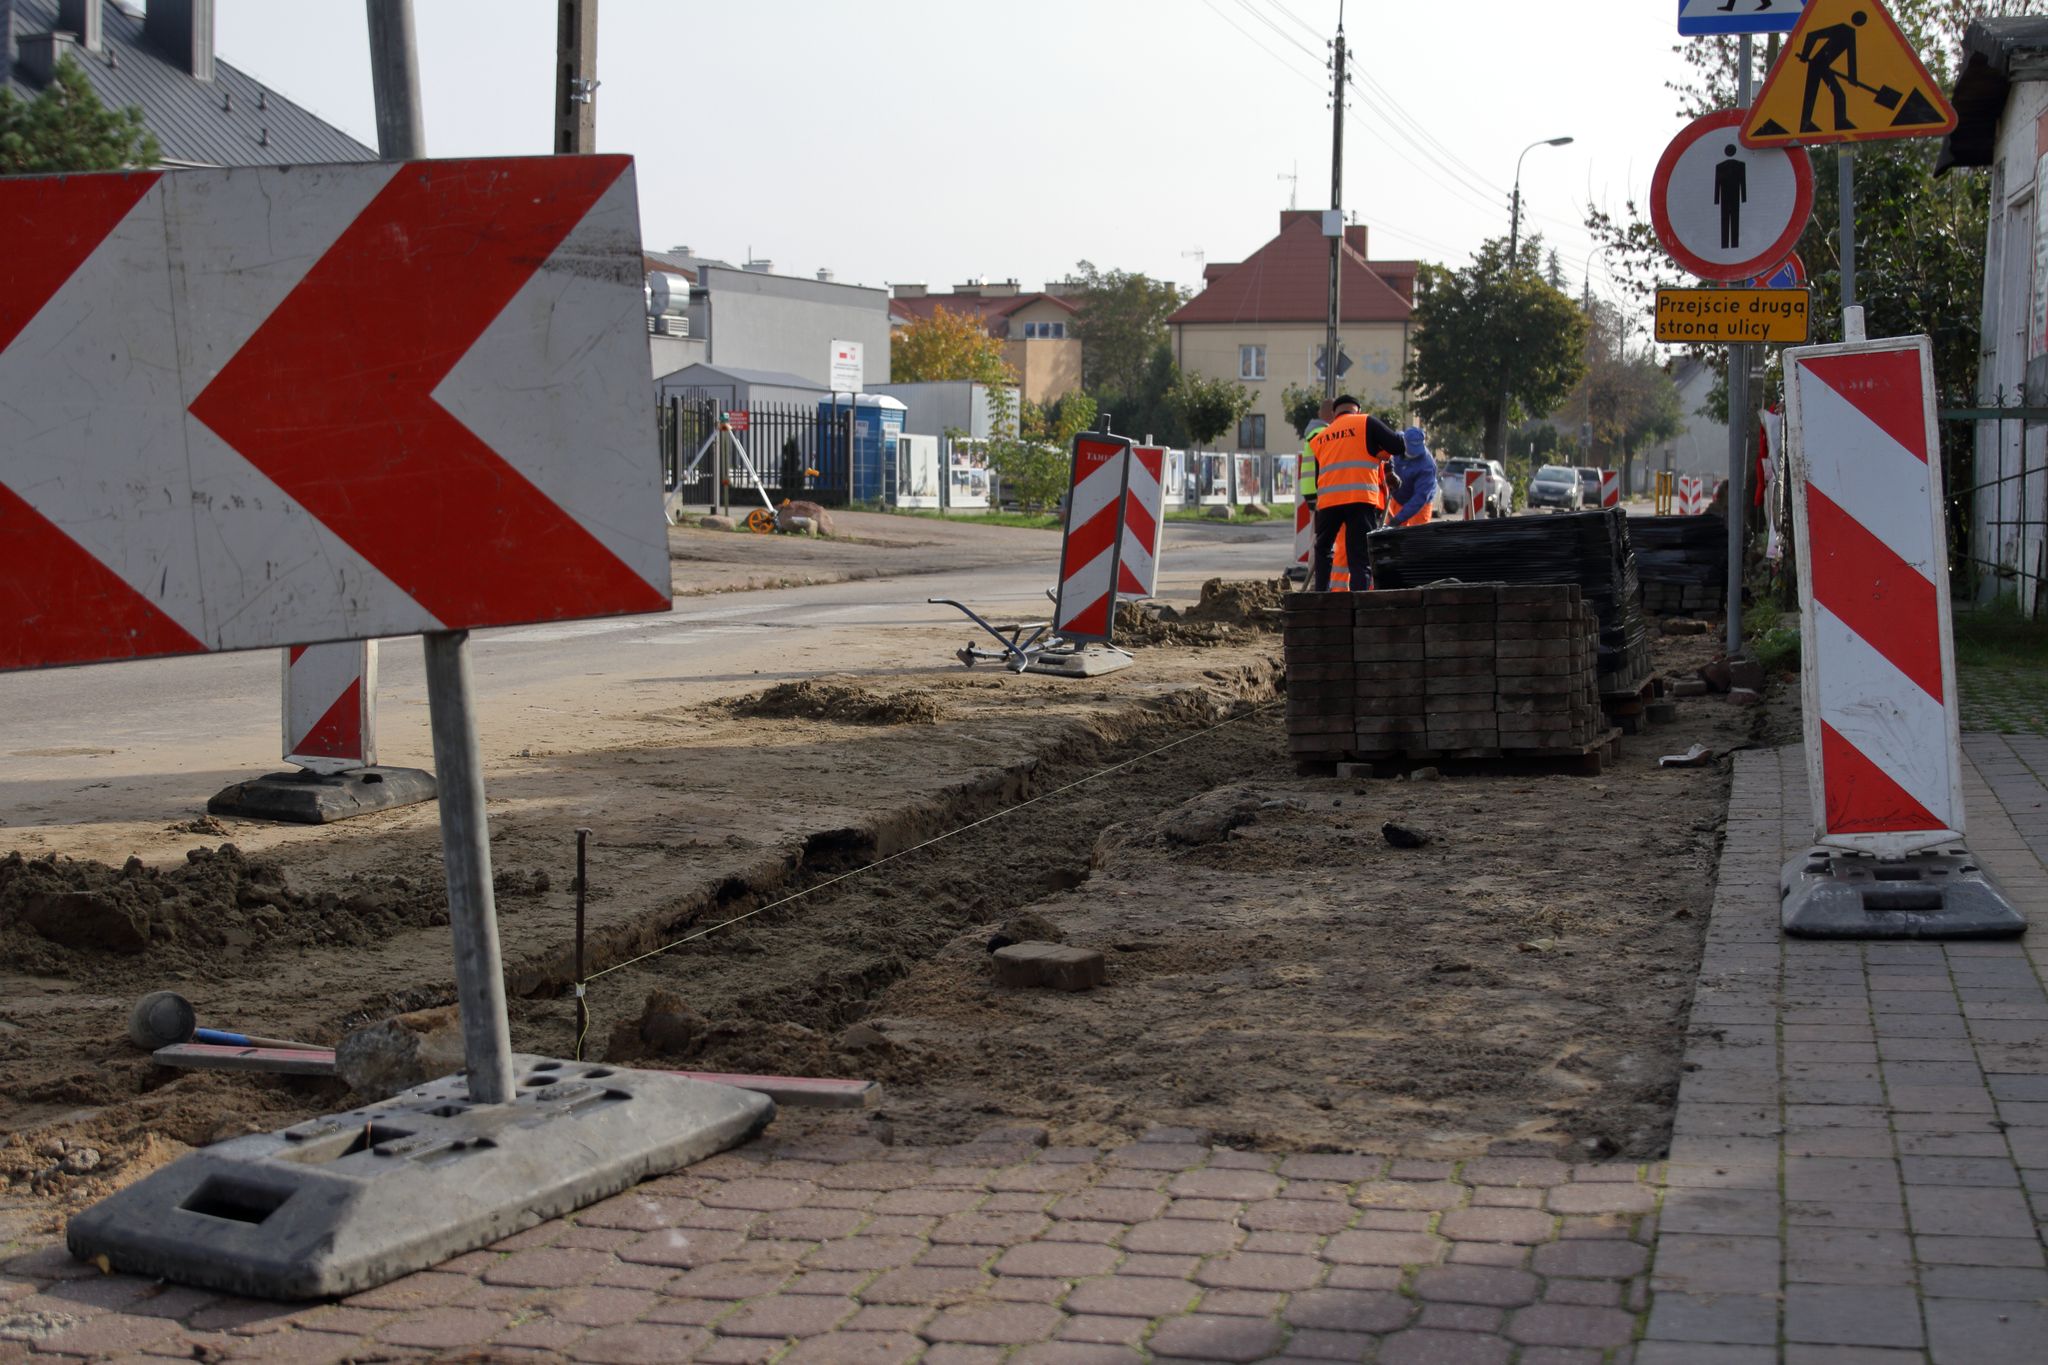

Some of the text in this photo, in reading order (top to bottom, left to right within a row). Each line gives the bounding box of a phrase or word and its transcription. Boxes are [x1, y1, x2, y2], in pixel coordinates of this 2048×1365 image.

[1660, 296, 1805, 318] Przejście drugą
[1660, 319, 1770, 340] stroną ulicy
[1317, 427, 1356, 445] TAMEX
